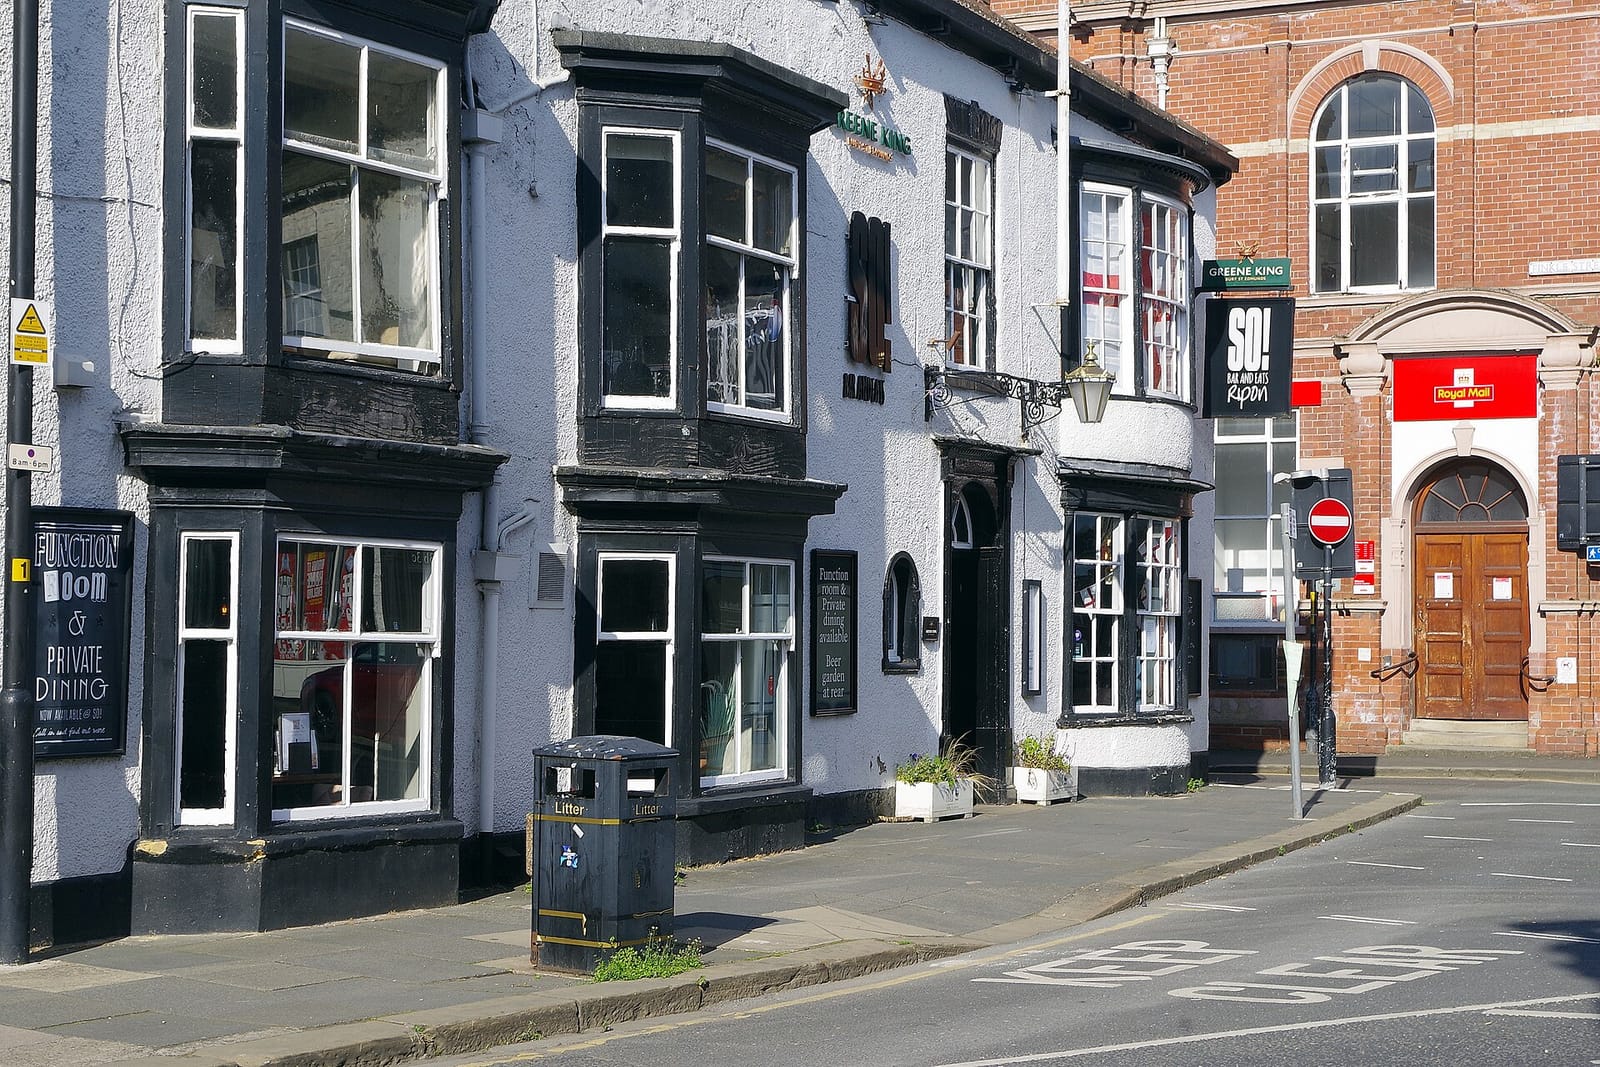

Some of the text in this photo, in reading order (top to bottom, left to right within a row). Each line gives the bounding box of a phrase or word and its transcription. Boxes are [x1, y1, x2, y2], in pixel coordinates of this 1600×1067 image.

[836, 111, 878, 142] REENE
[880, 125, 911, 155] KING
[1209, 266, 1283, 276] GREENE KING
[1228, 307, 1271, 371] SO!
[1227, 372, 1269, 384] BAR AND EATS
[1438, 387, 1490, 399] Royal Mail
[34, 532, 120, 568] FUNCTION
[20, 561, 27, 579] 1
[819, 567, 849, 581] Function
[821, 584, 847, 595] room &
[822, 597, 846, 611] Private
[68, 610, 87, 636] &
[823, 612, 845, 627] dining
[819, 628, 849, 643] available
[47, 646, 102, 674] PRIVATE
[826, 655, 841, 667] Beer
[821, 669, 845, 686] garden
[36, 677, 109, 701] DINING
[822, 688, 844, 698] at rear
[555, 802, 585, 816] Litter
[635, 804, 660, 816] Litter
[970, 939, 1259, 987] KEEP
[1166, 944, 1524, 1004] CLEAR
